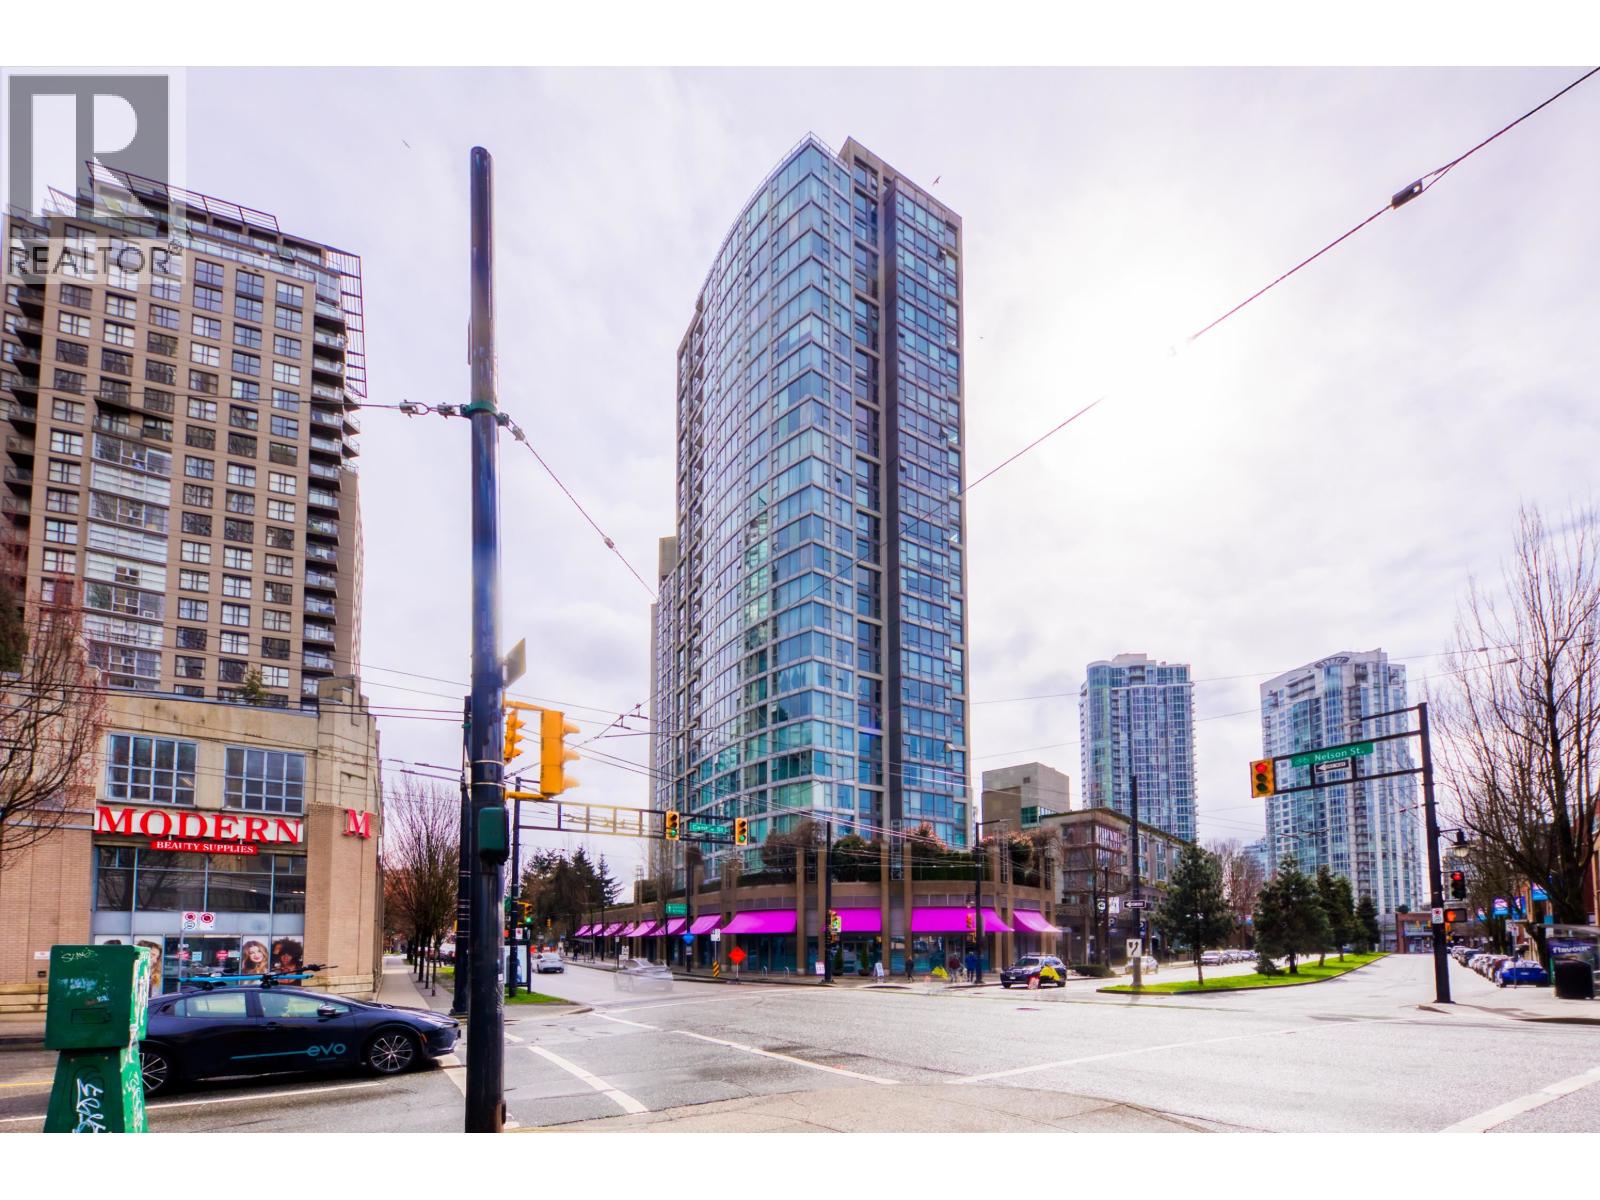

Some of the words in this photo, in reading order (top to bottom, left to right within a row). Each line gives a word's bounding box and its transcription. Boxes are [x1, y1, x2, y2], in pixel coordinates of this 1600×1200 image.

[1314, 750, 1347, 761] Nelson
[1350, 747, 1364, 755] St.
[96, 806, 301, 845] MODERN
[342, 808, 371, 839] M
[156, 841, 199, 851] BEAUTY
[202, 843, 254, 854] SUPPLIES
[307, 1042, 347, 1057] evo
